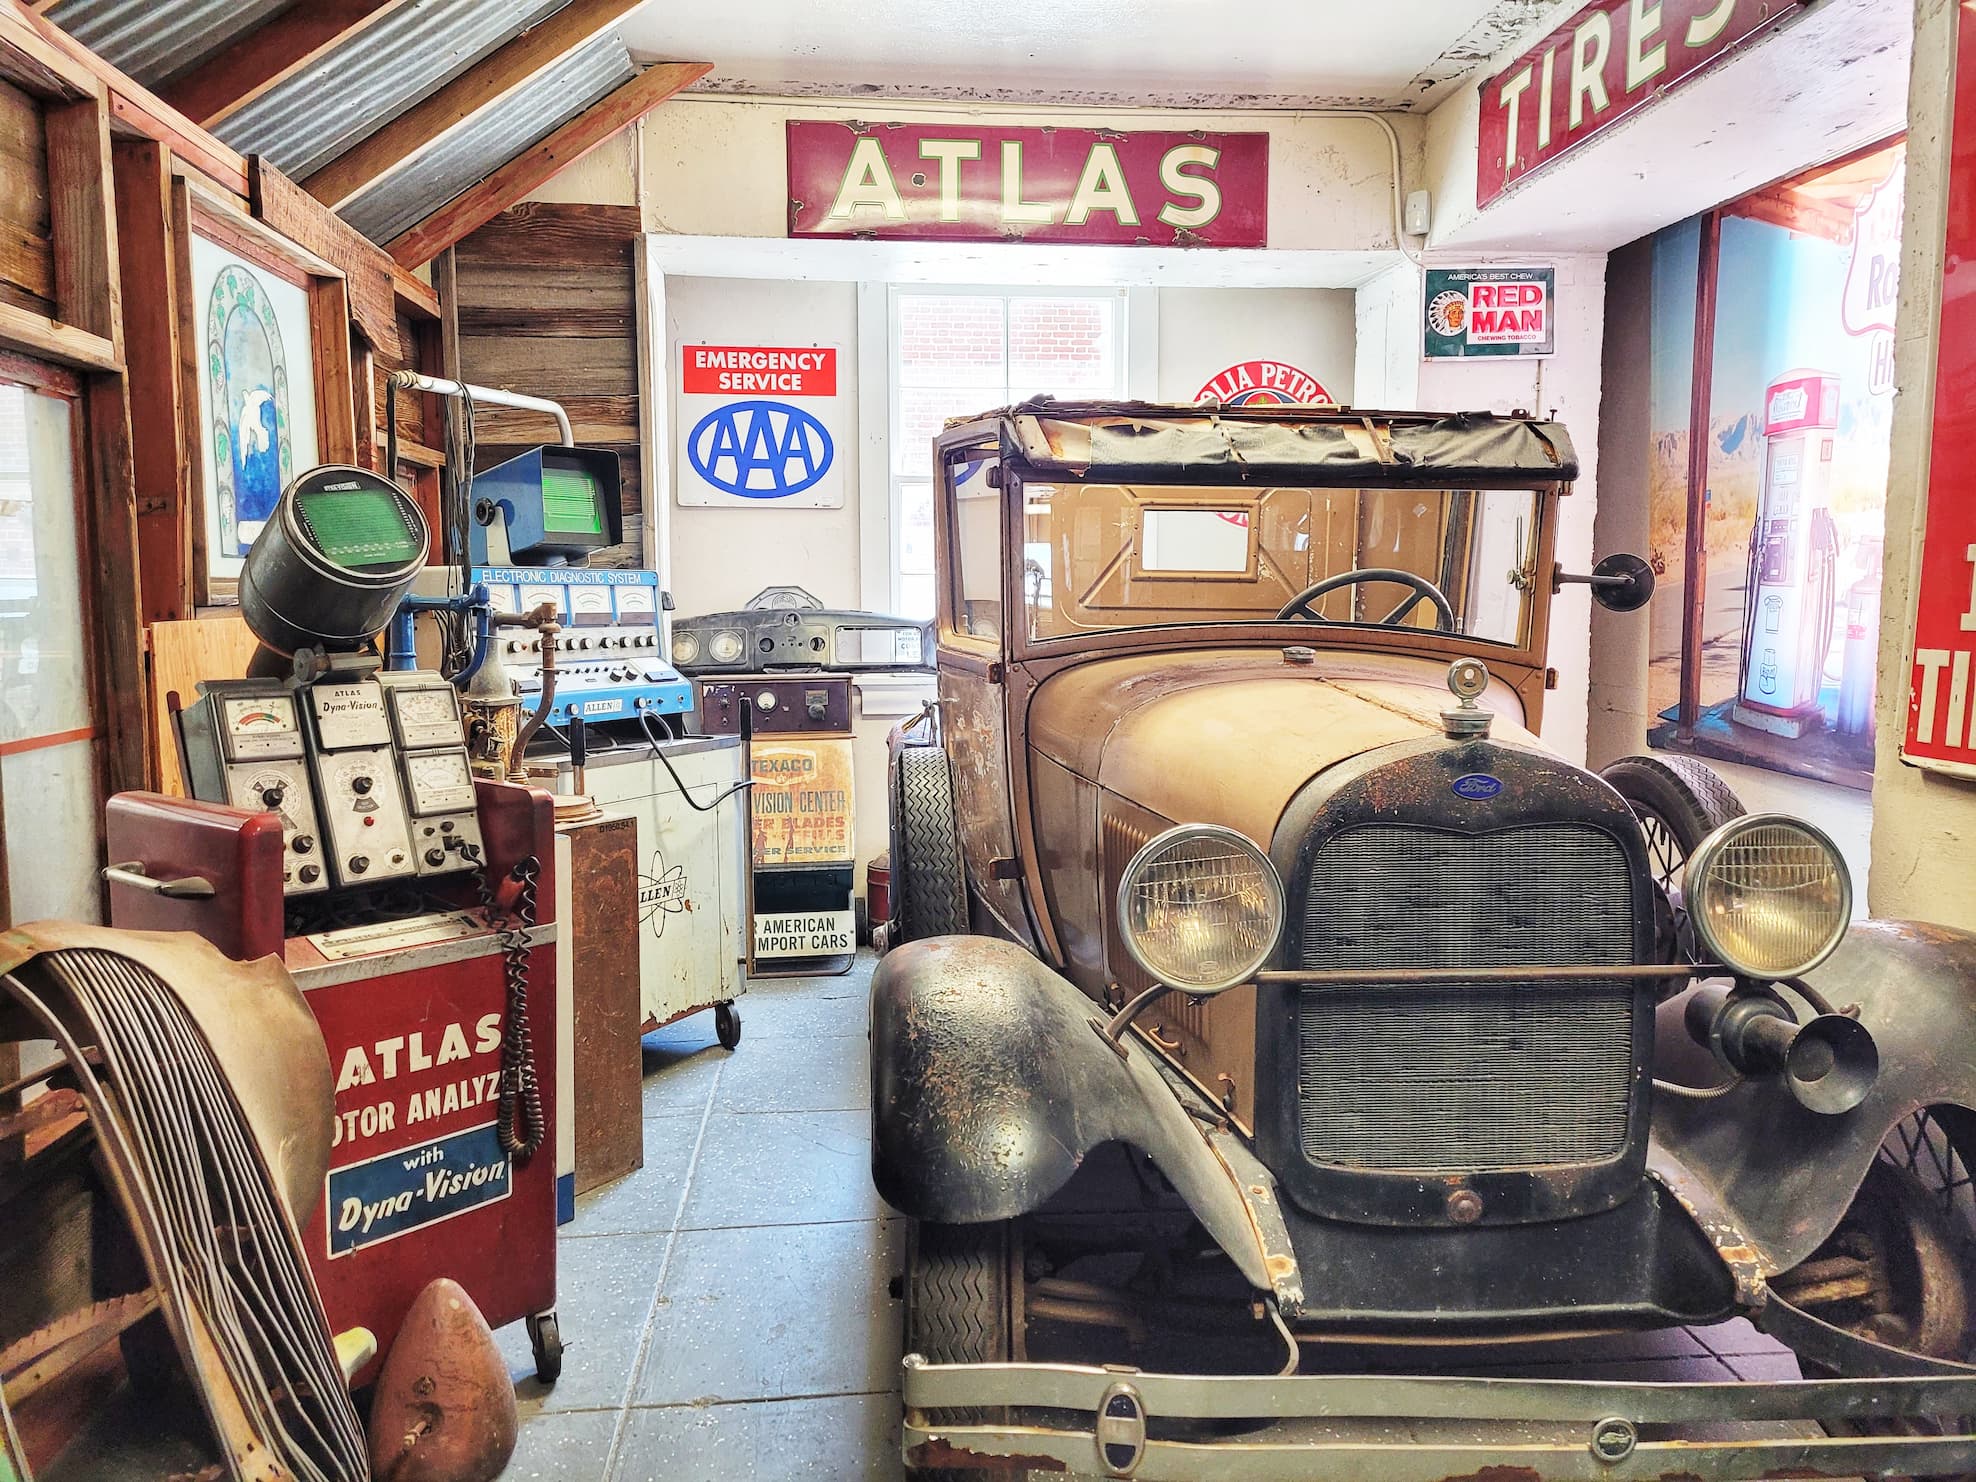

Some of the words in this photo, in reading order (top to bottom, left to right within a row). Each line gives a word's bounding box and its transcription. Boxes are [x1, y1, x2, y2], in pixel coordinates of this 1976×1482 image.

[829, 136, 1223, 228] ATLAS
[1447, 273, 1488, 281] AMERICA'S
[1472, 285, 1543, 308] RED
[1472, 310, 1543, 334] MAN
[695, 351, 826, 371] EMERGENCY
[719, 372, 802, 391] SERVICE
[700, 402, 820, 498] AAA
[482, 570, 547, 582] ELECTRONIC
[550, 571, 604, 583] DIAGNOSTIC
[607, 572, 642, 584] SYSTEM
[585, 701, 613, 714] ALLEN
[1916, 648, 1976, 750] TI
[752, 758, 813, 772] TEXACO
[1459, 778, 1496, 793] Ford
[754, 791, 793, 814] VISION
[800, 790, 845, 813] CENTER
[781, 816, 845, 830] BLADES
[786, 845, 847, 855] SERVICE
[639, 885, 672, 904] LLEN
[763, 917, 836, 934] AMERICAN
[811, 934, 848, 949] CARS
[335, 1013, 502, 1095] ATLAS
[331, 1101, 396, 1148] OTOR
[407, 1066, 524, 1126] ANALYZ
[403, 1146, 444, 1172] with
[338, 1160, 505, 1234] Dyna-Vision
